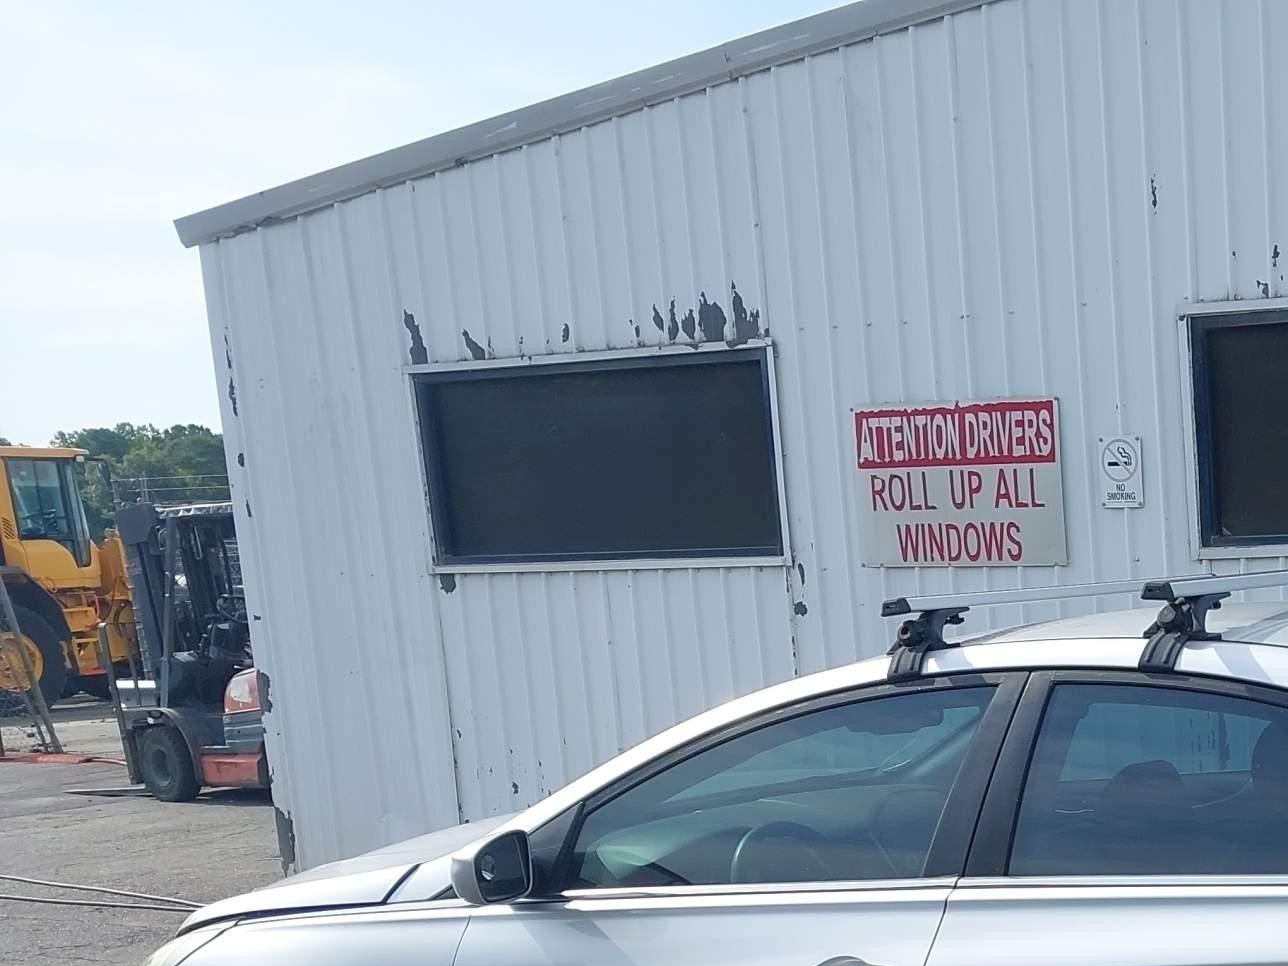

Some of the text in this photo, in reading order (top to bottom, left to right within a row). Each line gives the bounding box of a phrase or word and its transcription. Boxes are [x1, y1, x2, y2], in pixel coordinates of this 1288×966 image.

[859, 409, 1051, 463] ATTENTION DRIVERS
[870, 467, 1045, 512] ROLL UP ALL
[1106, 491, 1136, 501] SMOKING
[1115, 483, 1126, 492] NO
[896, 521, 1023, 563] WINDOWS
